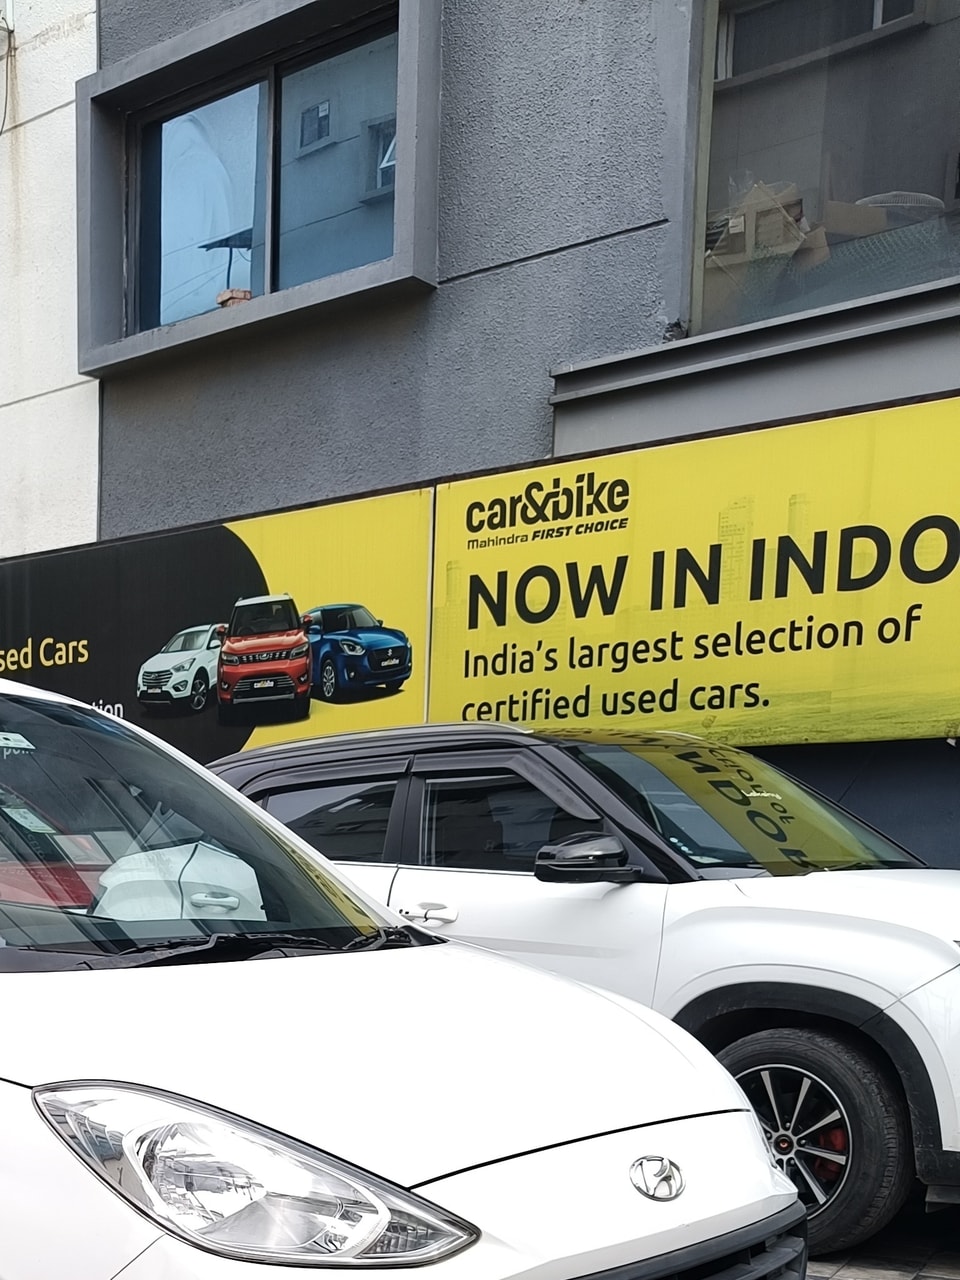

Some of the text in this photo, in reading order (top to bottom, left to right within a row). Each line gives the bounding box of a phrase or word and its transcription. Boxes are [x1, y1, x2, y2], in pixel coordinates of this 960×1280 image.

[466, 472, 630, 533] car&bike
[467, 518, 629, 550] Mahindra FIRST CHOICE
[467, 514, 960, 630] NOW IN INDO
[40, 637, 89, 667] Cars
[568, 630, 683, 673] largest
[693, 615, 863, 656] selection
[877, 604, 922, 643] of
[462, 678, 770, 722] certified used cars.
